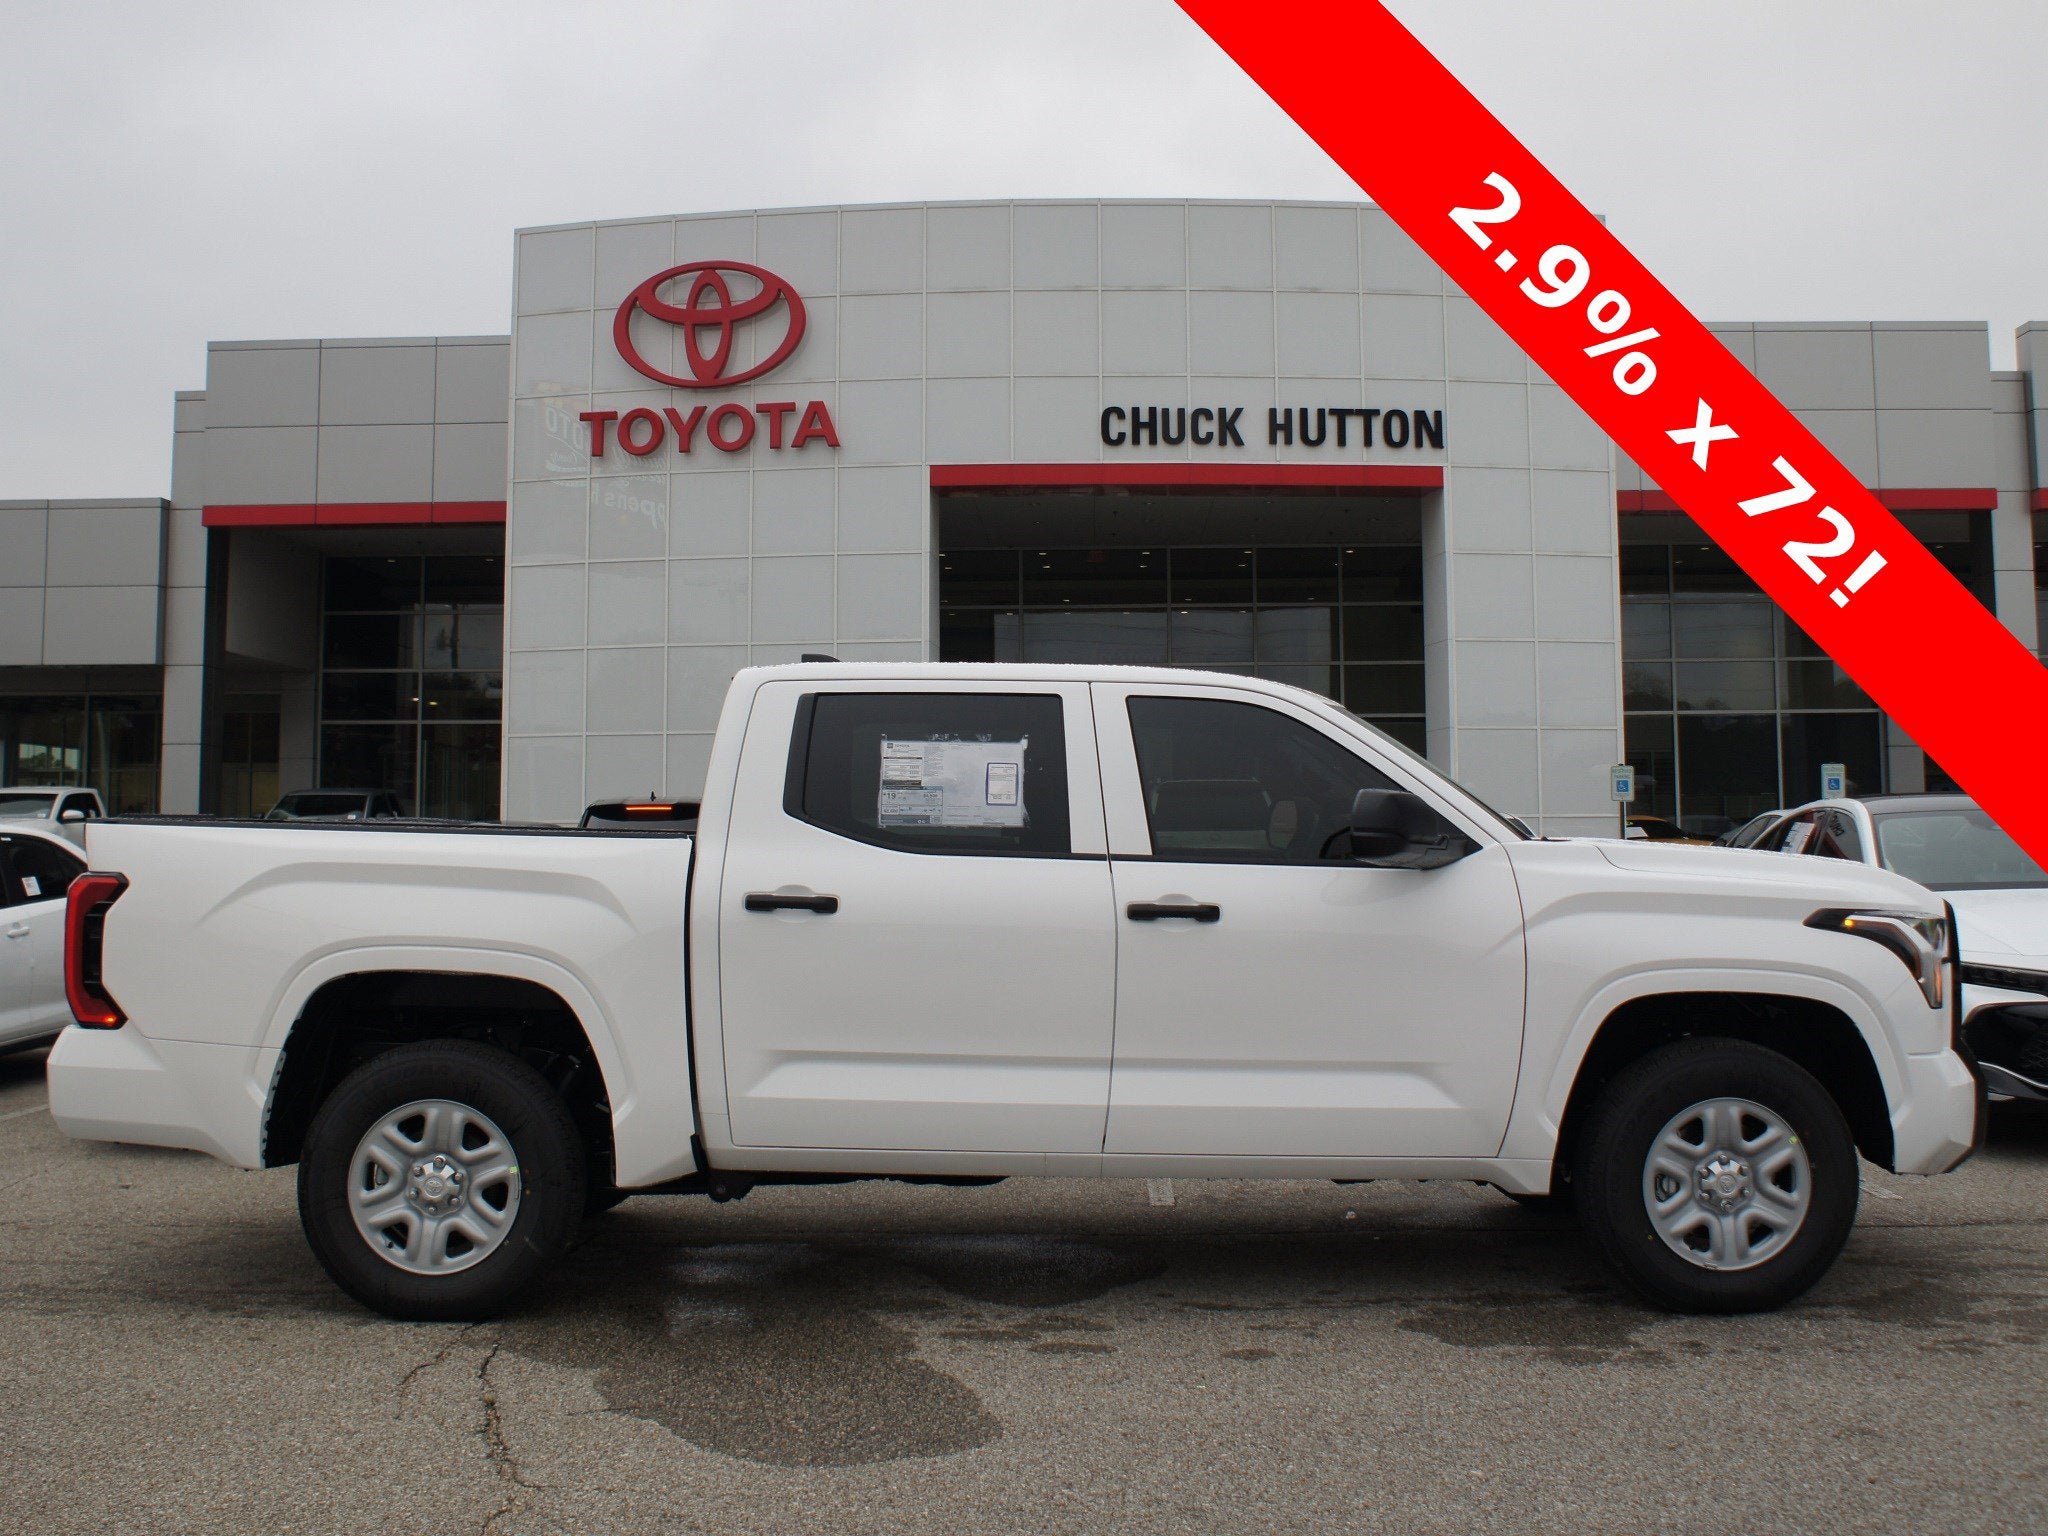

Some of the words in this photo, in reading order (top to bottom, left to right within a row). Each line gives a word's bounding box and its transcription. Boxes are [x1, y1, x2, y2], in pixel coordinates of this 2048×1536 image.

[579, 400, 841, 457] TOYOTA
[1100, 405, 1246, 448] CHUCK
[1268, 407, 1445, 450] HUTTON
